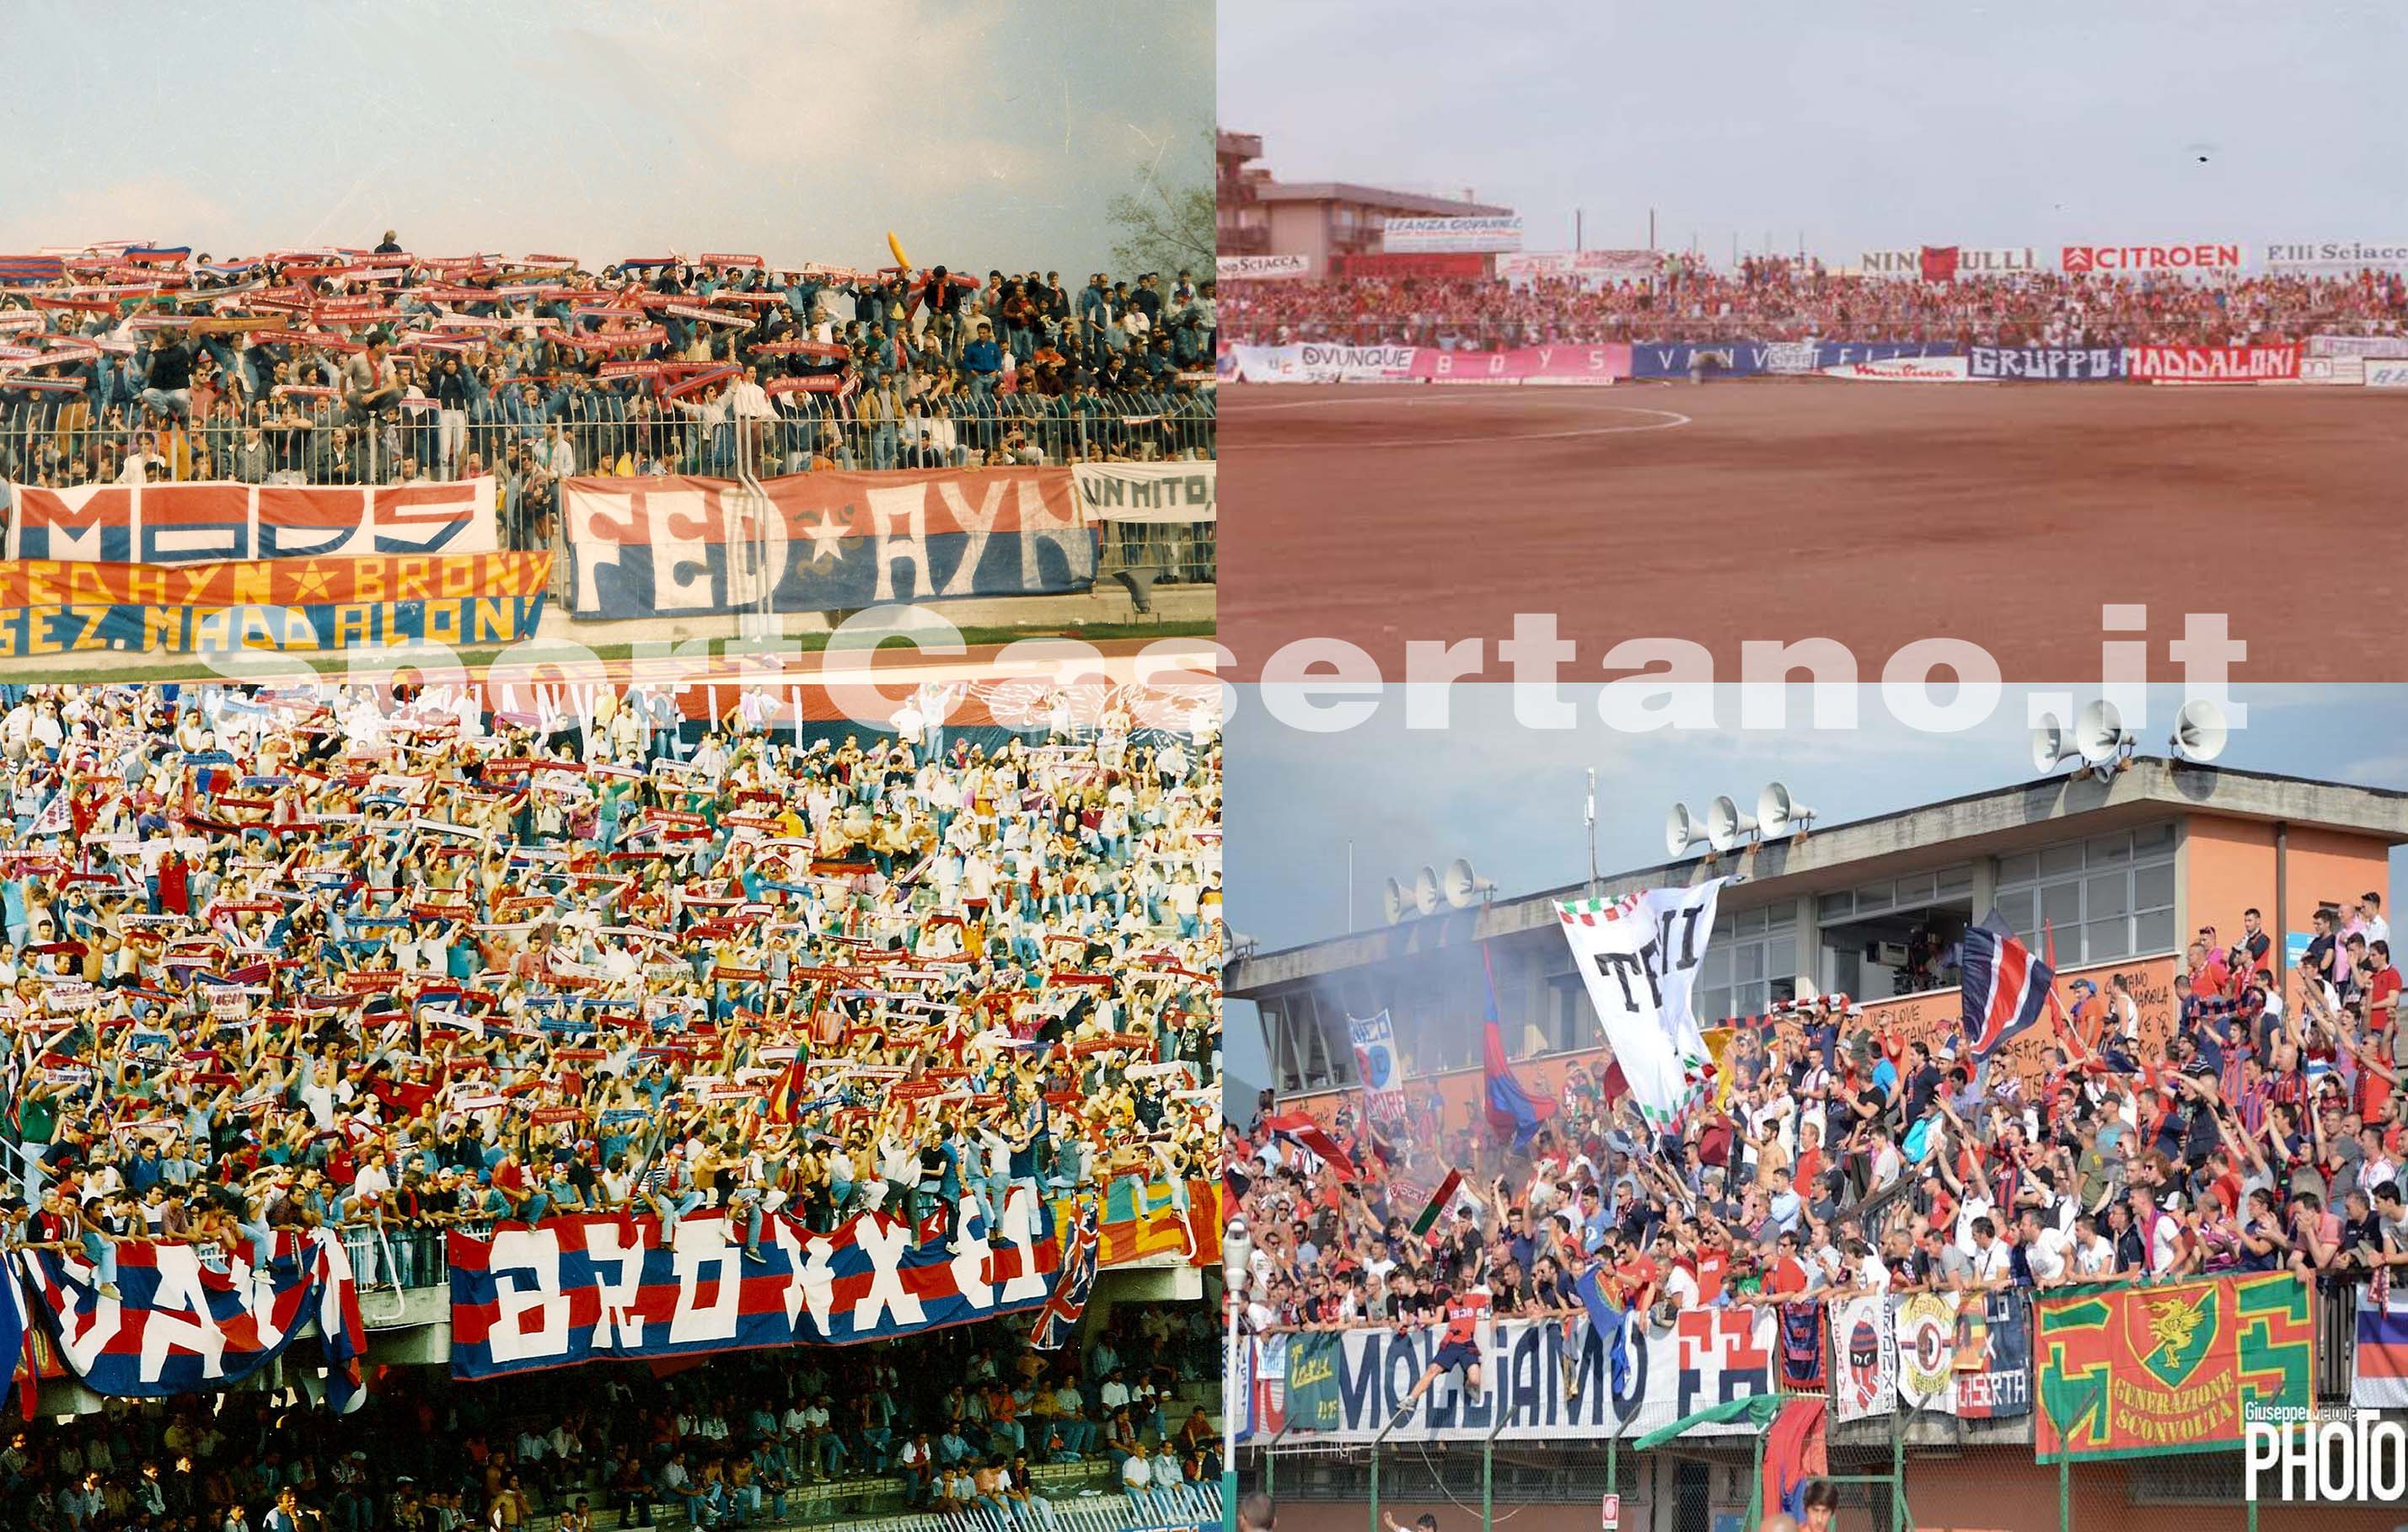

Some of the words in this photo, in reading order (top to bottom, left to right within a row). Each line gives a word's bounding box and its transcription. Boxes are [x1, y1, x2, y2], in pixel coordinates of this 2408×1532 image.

[2095, 244, 2239, 270] CITROEN
[2115, 1369, 2235, 1415] GENERAZIONE
[2116, 1398, 2236, 1442] SCONVOLTA
